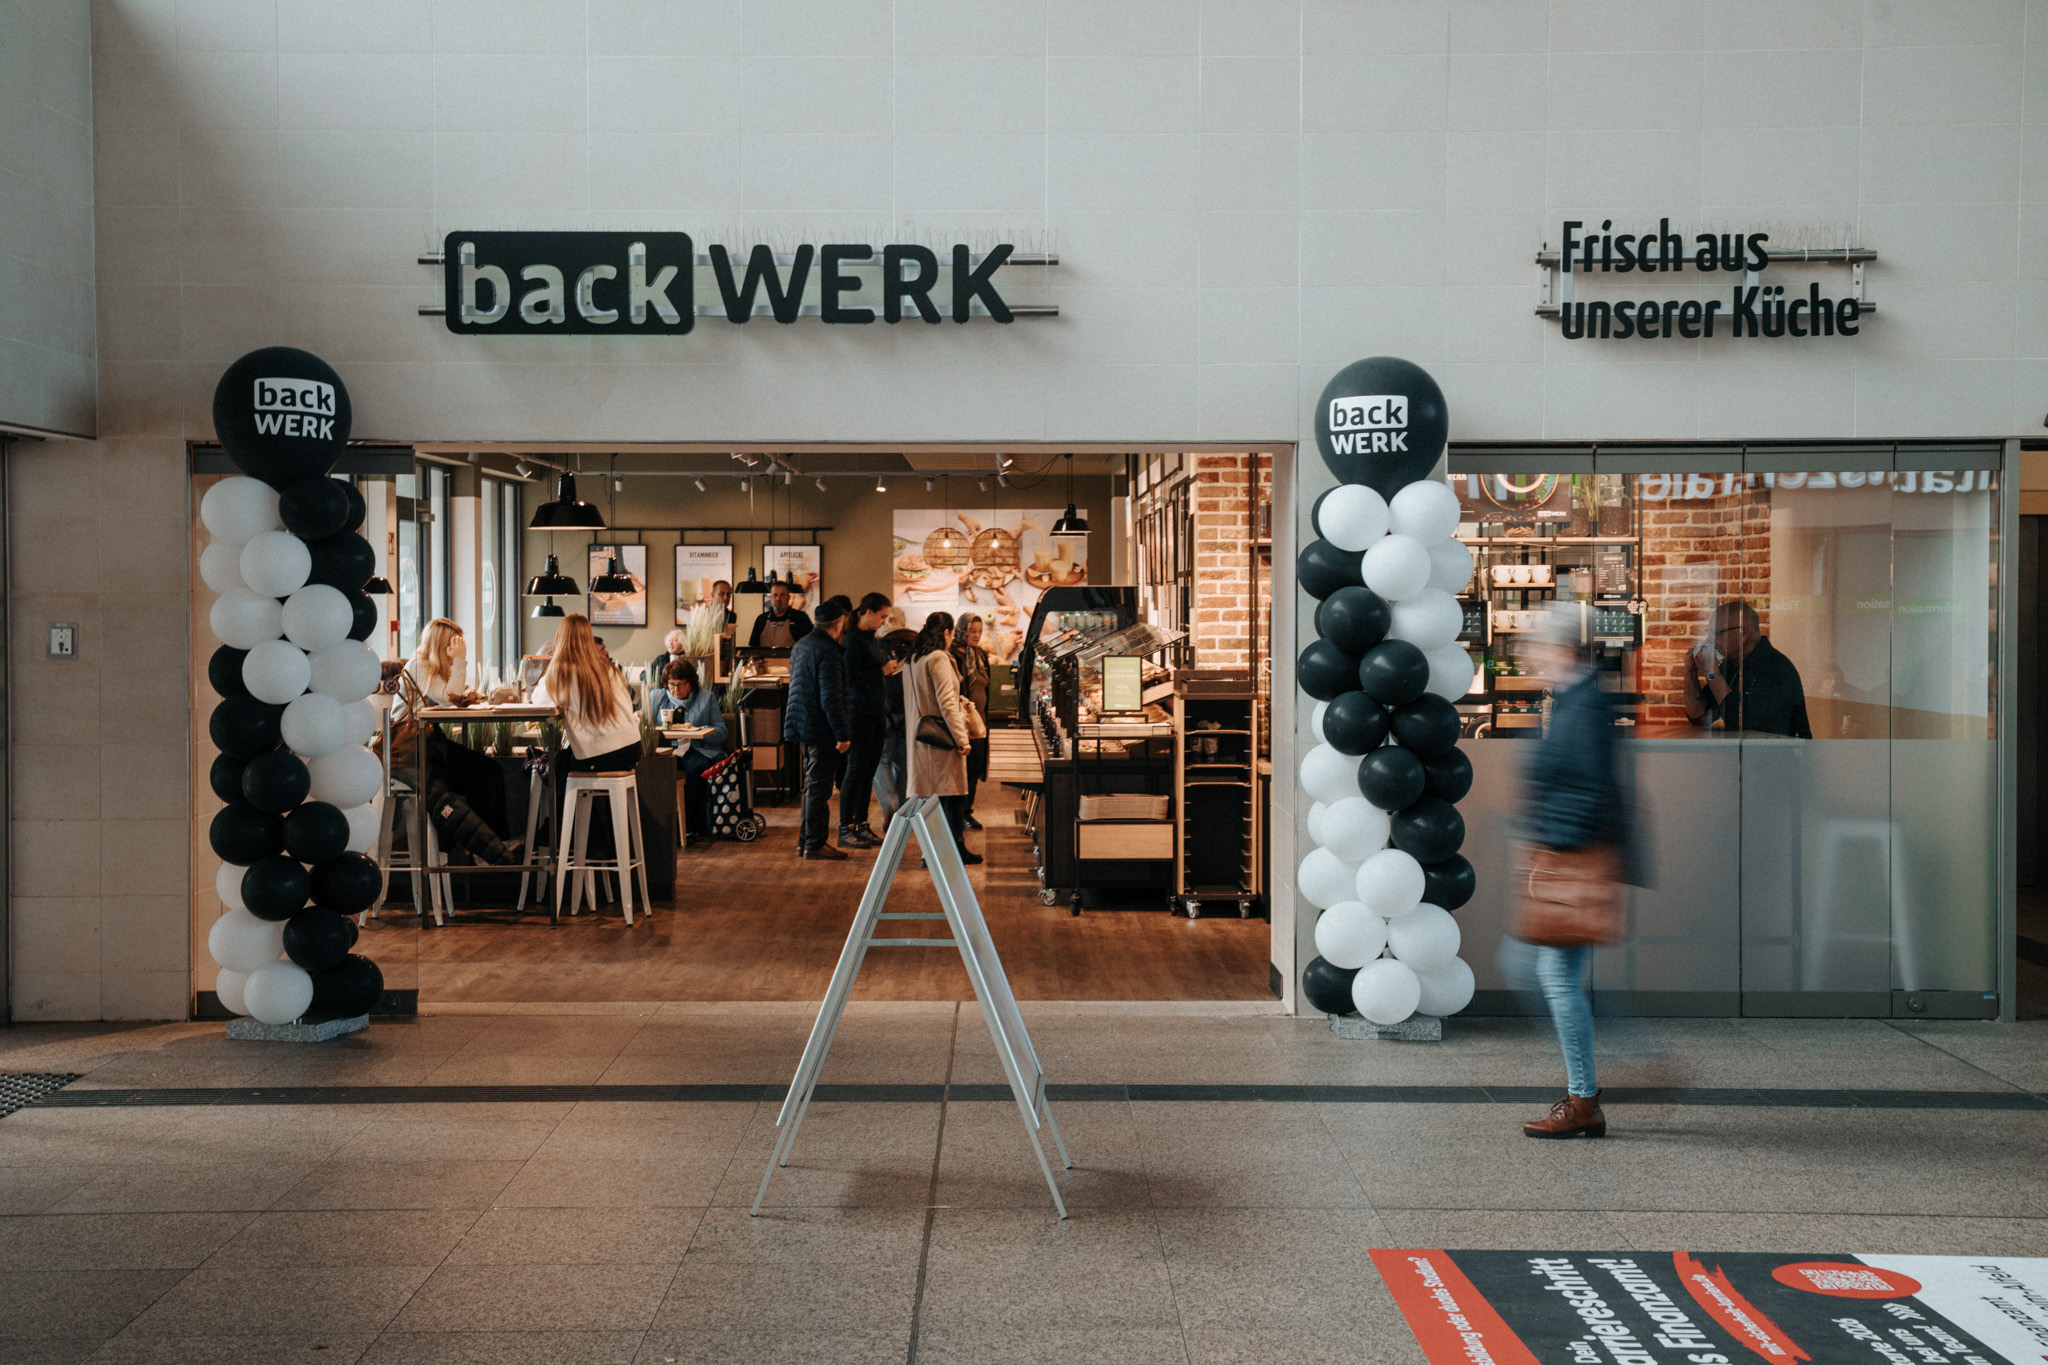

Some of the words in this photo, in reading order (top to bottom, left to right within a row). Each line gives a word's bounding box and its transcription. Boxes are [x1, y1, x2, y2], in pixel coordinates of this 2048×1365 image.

[1562, 218, 1683, 273] Frisch
[1696, 233, 1768, 272] aus
[458, 240, 682, 326] back
[708, 244, 1015, 325] WERK
[1562, 300, 1721, 339] unserer
[1733, 283, 1859, 338] Küche
[258, 381, 332, 412] back
[254, 413, 335, 440] WERK
[1334, 399, 1403, 427] back
[1330, 431, 1408, 454] WERK
[689, 551, 719, 559] VITAMINKICK
[1407, 1257, 1445, 1287] Studium?
[1430, 1288, 1461, 1312] duales
[1586, 1258, 1716, 1348] Finanzamt!
[1446, 1312, 1473, 1331] oder
[1831, 1318, 1883, 1341] 2026
[1888, 1328, 1925, 1346] uns
[1912, 1325, 1974, 1354] Team!
[1565, 1341, 1603, 1364] Dein
[1905, 1346, 1951, 1363] bei
